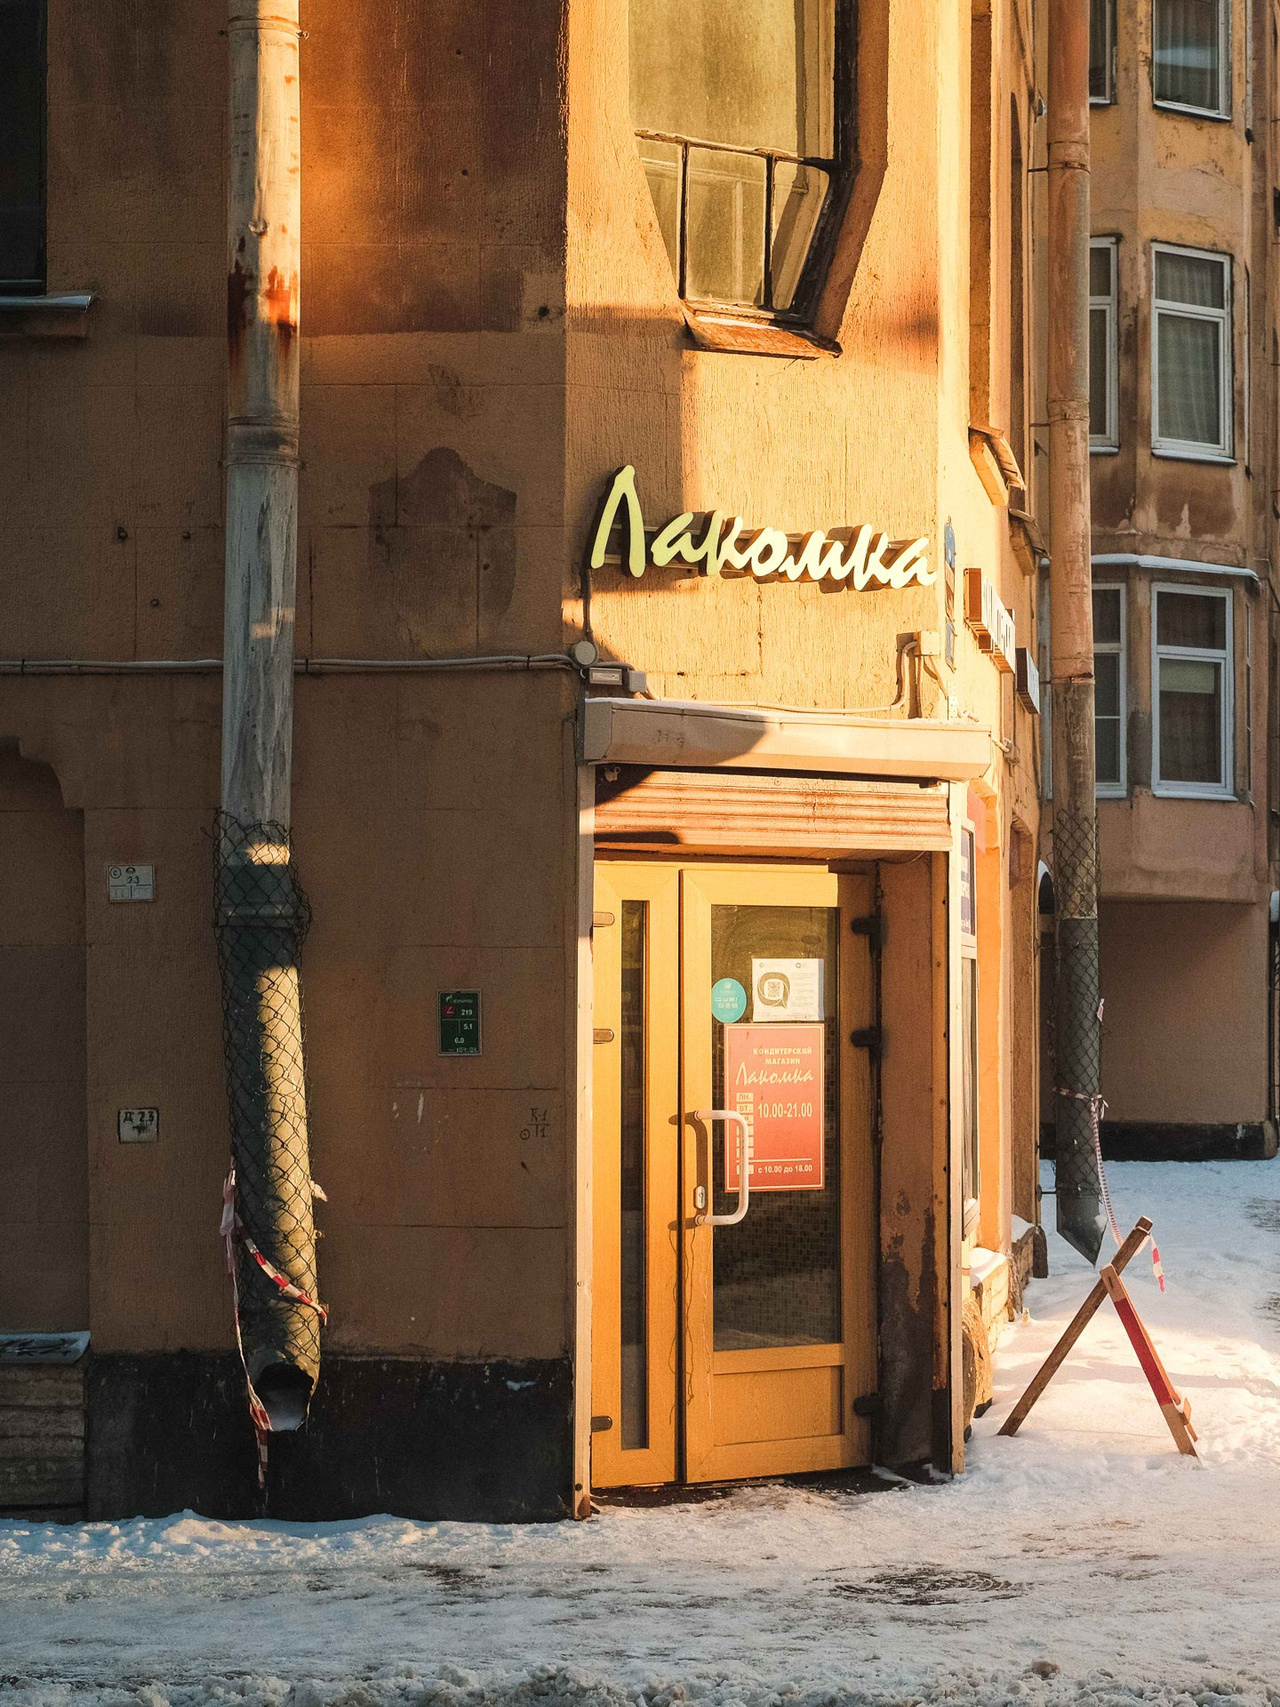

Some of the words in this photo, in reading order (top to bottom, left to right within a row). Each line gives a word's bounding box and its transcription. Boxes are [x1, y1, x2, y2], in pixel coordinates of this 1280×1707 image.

[590, 465, 938, 591] Лакомка
[753, 1046, 812, 1055] КОНДИТЕРСКИЙ
[735, 1061, 815, 1086] Лакомка
[757, 1102, 813, 1119] 10.00-21.00
[757, 1166, 762, 1174] с
[764, 1165, 782, 1174] 10.00
[783, 1166, 793, 1174] до
[795, 1164, 813, 1173] 18.00
